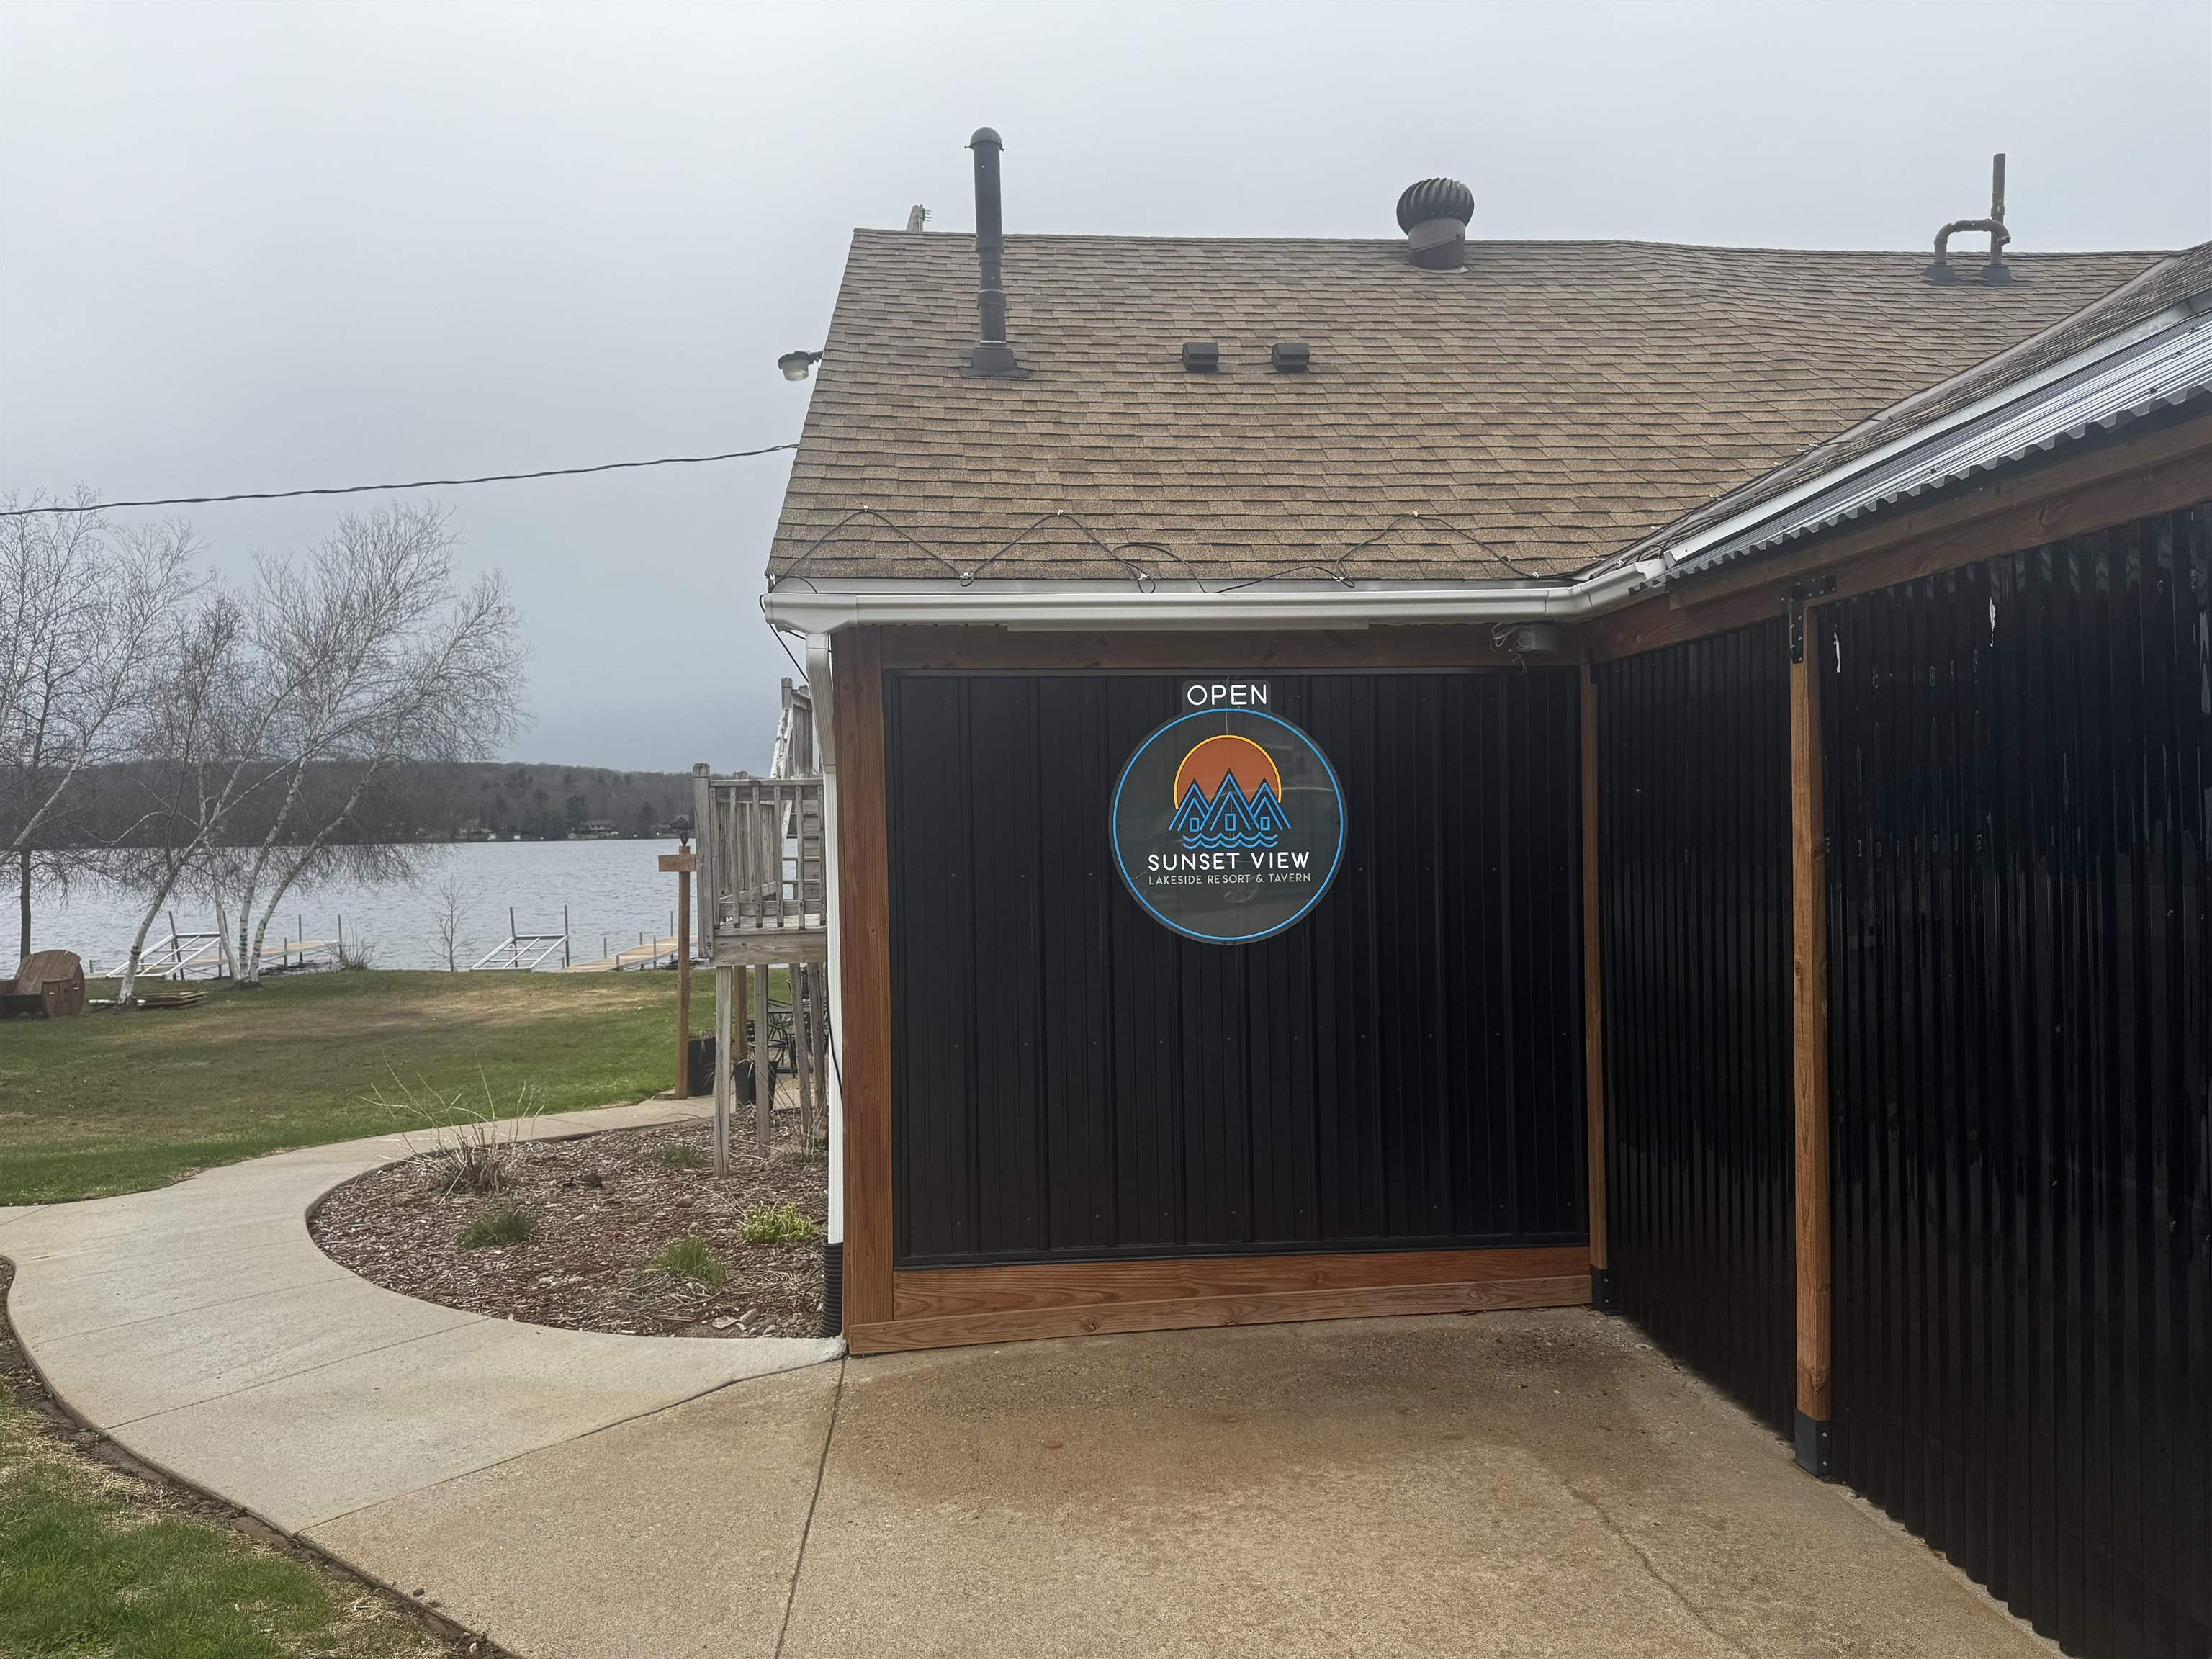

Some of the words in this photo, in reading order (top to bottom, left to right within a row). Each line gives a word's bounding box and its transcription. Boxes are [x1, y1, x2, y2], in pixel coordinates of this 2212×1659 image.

[1187, 684, 1267, 706] OPEN
[1148, 852, 1240, 871] SUNSET
[1251, 851, 1310, 870] VIEW
[1148, 874, 1202, 885] LAKESIDE
[1207, 873, 1251, 884] RESORT
[1256, 873, 1264, 883] &
[1268, 873, 1310, 883] TAVERN
